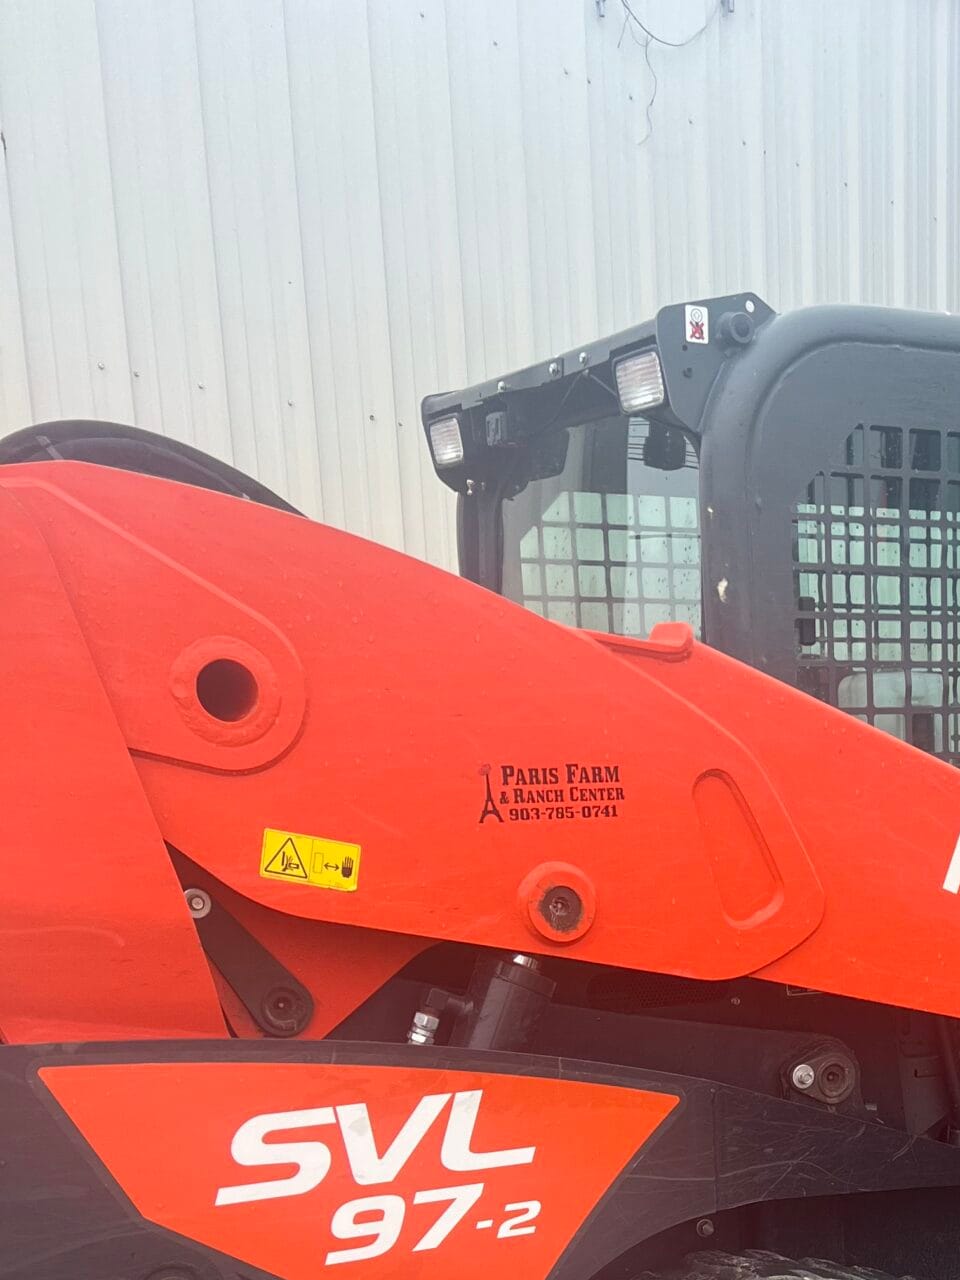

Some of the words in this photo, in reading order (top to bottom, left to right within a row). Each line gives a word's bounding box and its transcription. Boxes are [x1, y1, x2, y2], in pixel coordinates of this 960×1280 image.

[501, 764, 559, 786] PARIS
[565, 763, 620, 784] FARM
[499, 790, 510, 805] &
[513, 787, 564, 805] RANCH
[569, 786, 625, 803] CENTER
[509, 805, 618, 821] 903-785-0741
[214, 1089, 536, 1206] SVL
[324, 1182, 541, 1266] 97-2
